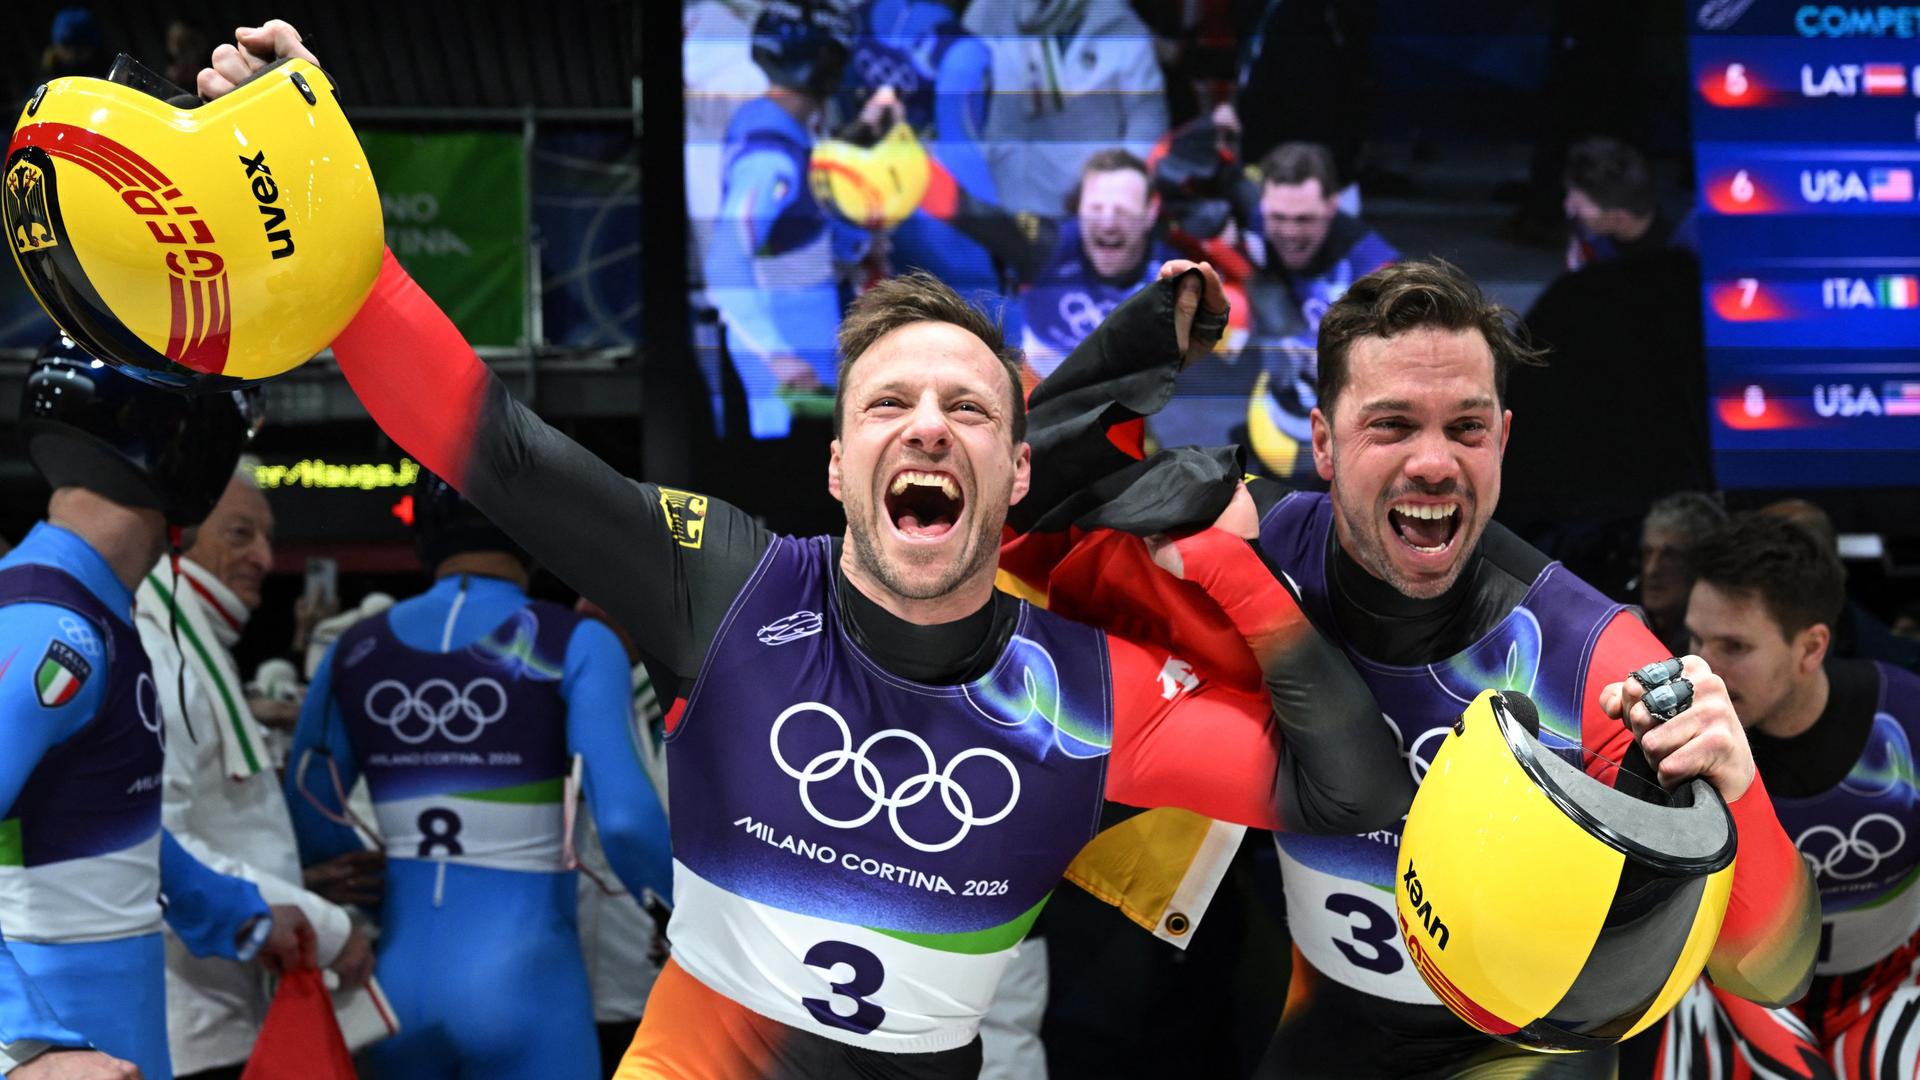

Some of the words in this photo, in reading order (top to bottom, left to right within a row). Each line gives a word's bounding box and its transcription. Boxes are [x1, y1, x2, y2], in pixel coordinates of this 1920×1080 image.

[1801, 64, 1861, 97] LAT
[239, 150, 295, 260] uvex
[1730, 170, 1755, 203] 6
[1801, 170, 1867, 202] USA
[1737, 278, 1759, 310] 7
[1822, 278, 1876, 309] ITA
[1743, 384, 1767, 418] 8
[1814, 384, 1883, 417] USA
[417, 807, 464, 857] 8
[734, 816, 837, 864] MILANO
[841, 853, 957, 895] CORTINA
[962, 879, 1010, 897] 2026
[1325, 892, 1405, 976] 3
[1403, 858, 1450, 951] uvex
[802, 939, 887, 1036] 3
